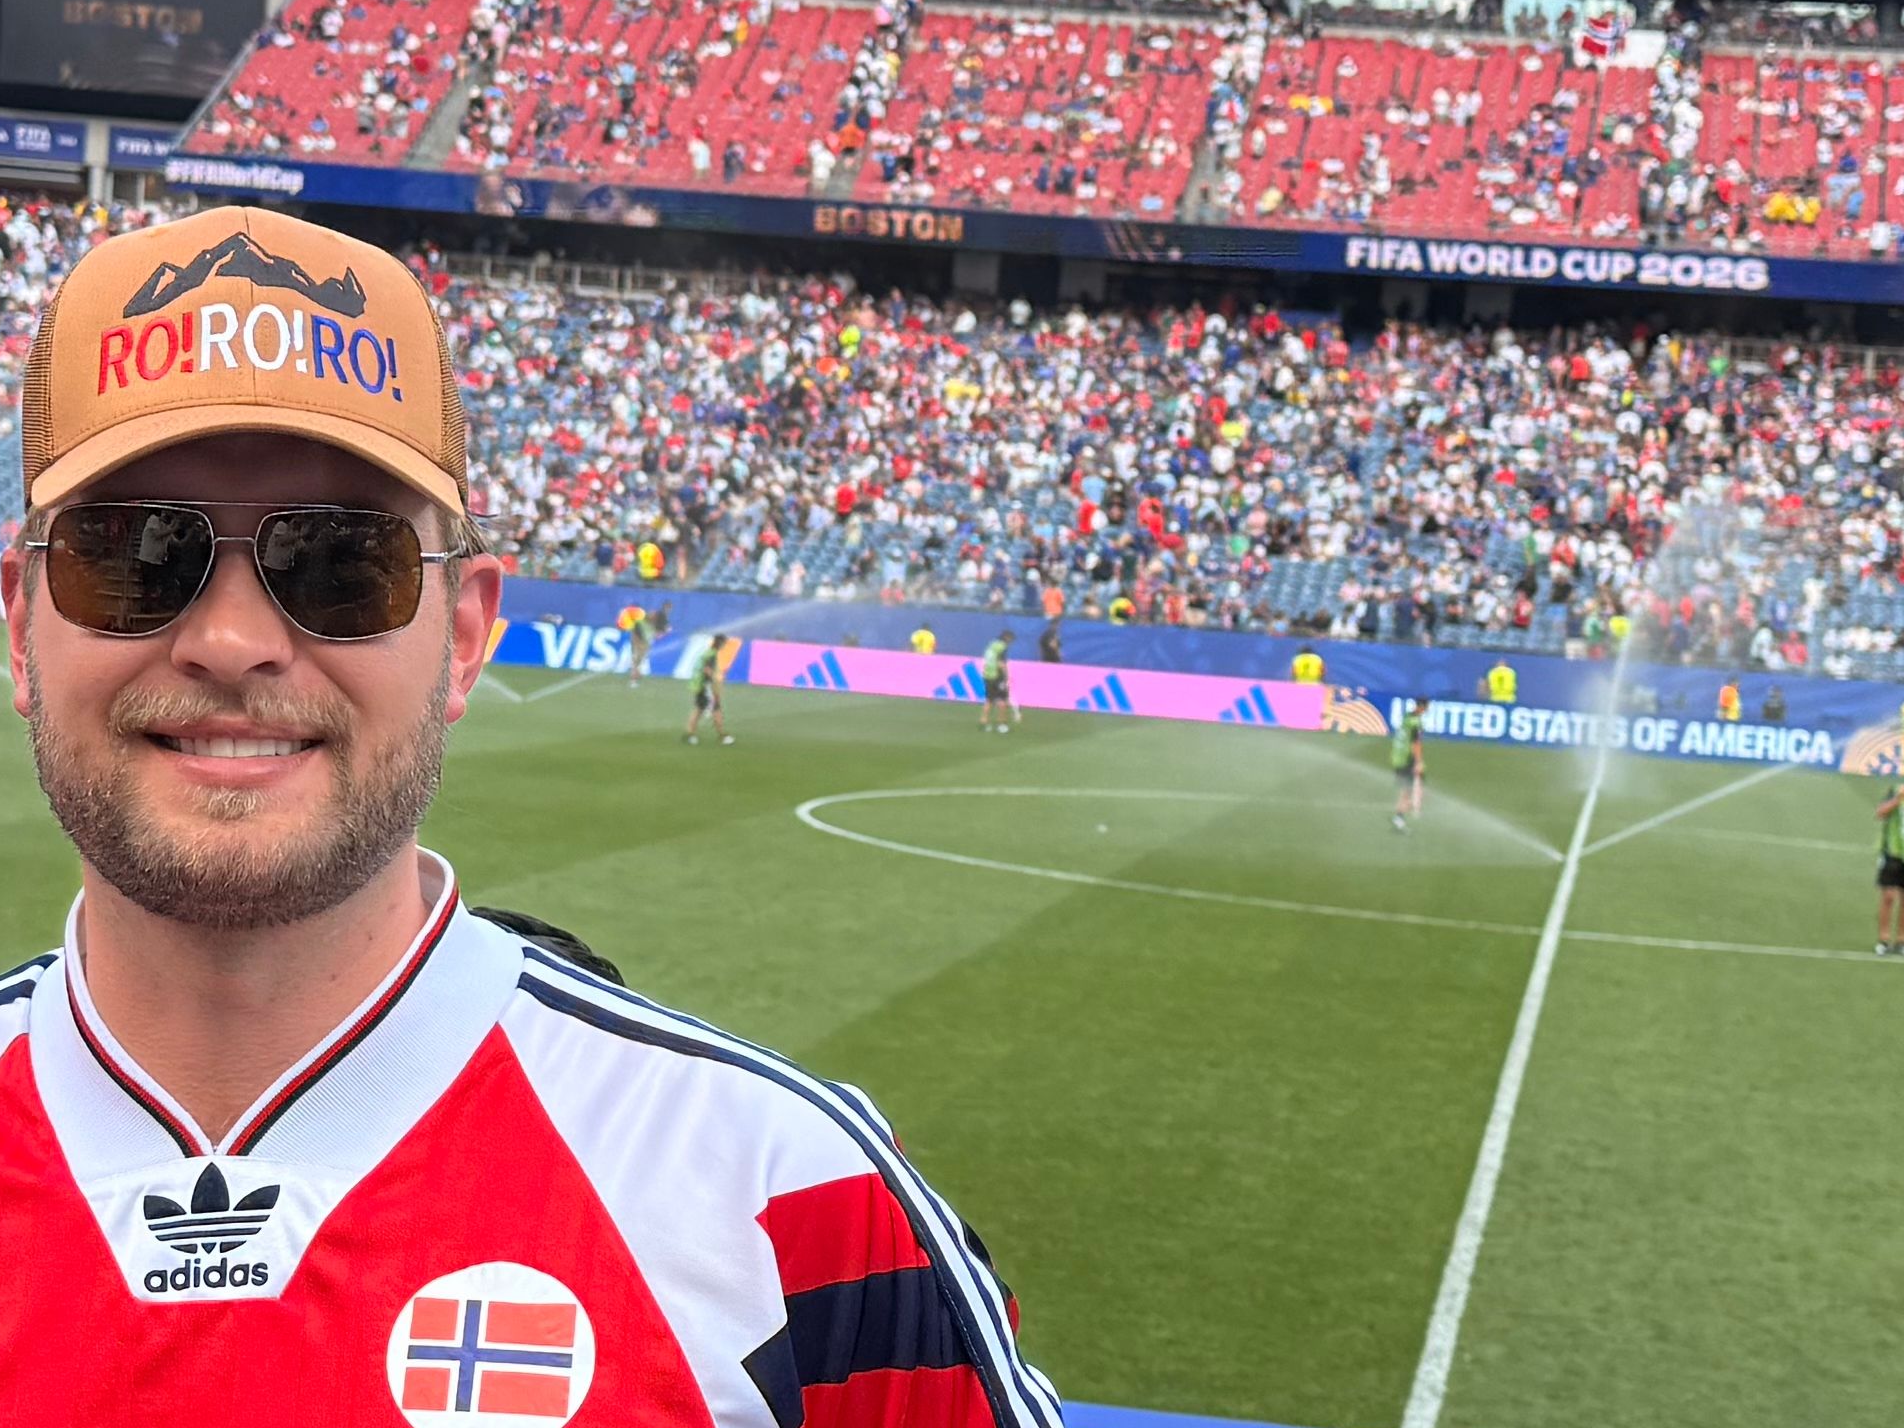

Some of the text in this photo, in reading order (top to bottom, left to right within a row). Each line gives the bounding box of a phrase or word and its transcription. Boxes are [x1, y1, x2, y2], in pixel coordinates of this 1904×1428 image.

[814, 207, 963, 241] BOSTON
[1346, 237, 1769, 291] FIFA WORLD CUP 2026
[531, 622, 651, 676] VISA
[1390, 697, 1834, 765] UNITED STATES OF AMERICA
[143, 1258, 269, 1294] adidas
